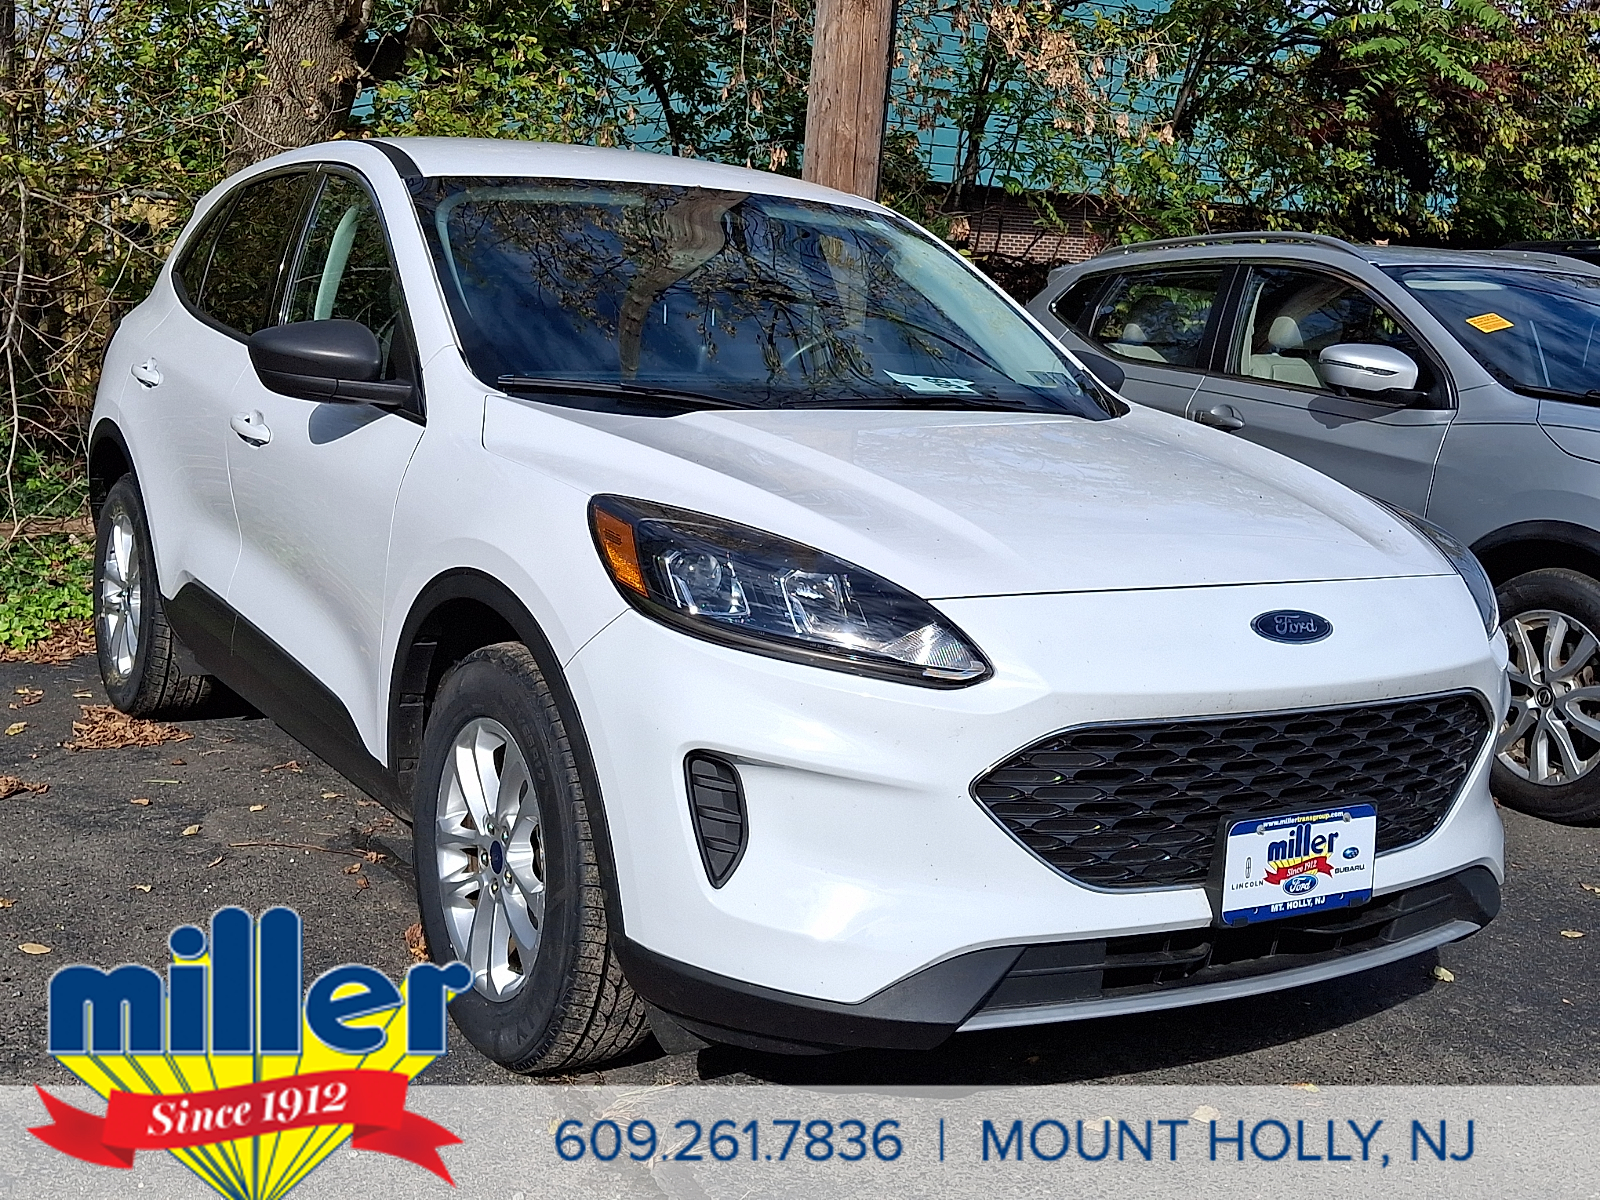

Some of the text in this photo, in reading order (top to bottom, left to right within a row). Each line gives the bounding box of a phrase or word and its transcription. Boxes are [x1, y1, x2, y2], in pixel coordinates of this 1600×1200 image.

[1274, 614, 1318, 635] Ford
[1267, 824, 1339, 861] miller
[1334, 864, 1365, 874] SUBARU
[1231, 880, 1264, 890] LINCOLN
[1289, 877, 1312, 893] Ford
[1271, 896, 1325, 912] MT. HOLLY, NJ
